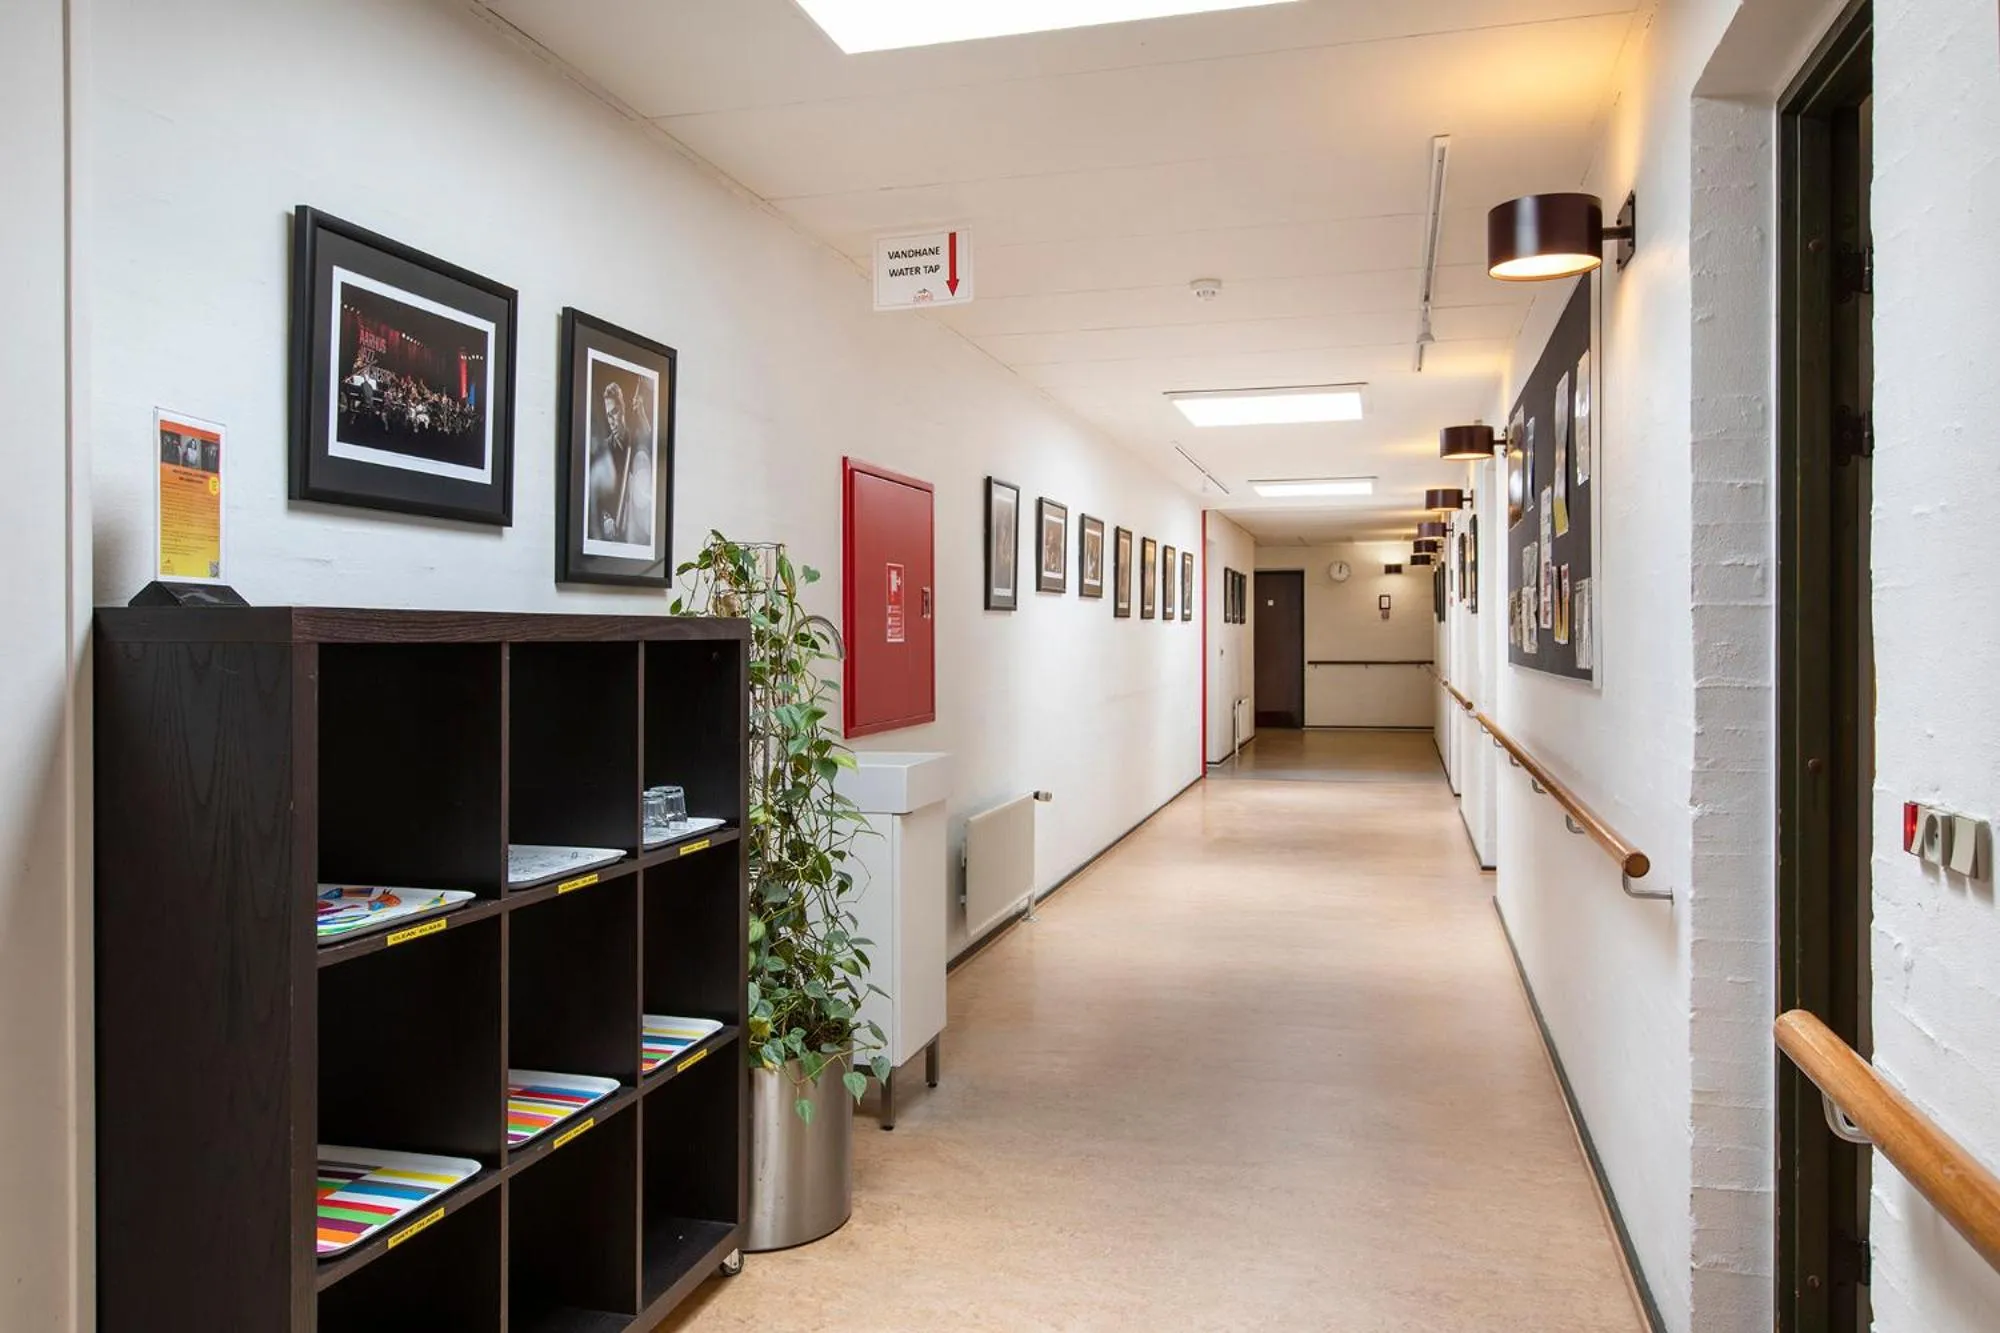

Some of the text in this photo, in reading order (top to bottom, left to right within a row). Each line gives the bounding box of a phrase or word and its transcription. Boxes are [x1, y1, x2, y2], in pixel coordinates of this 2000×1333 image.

[887, 246, 941, 260] VANDHANE
[888, 264, 941, 278] WATER TAP
